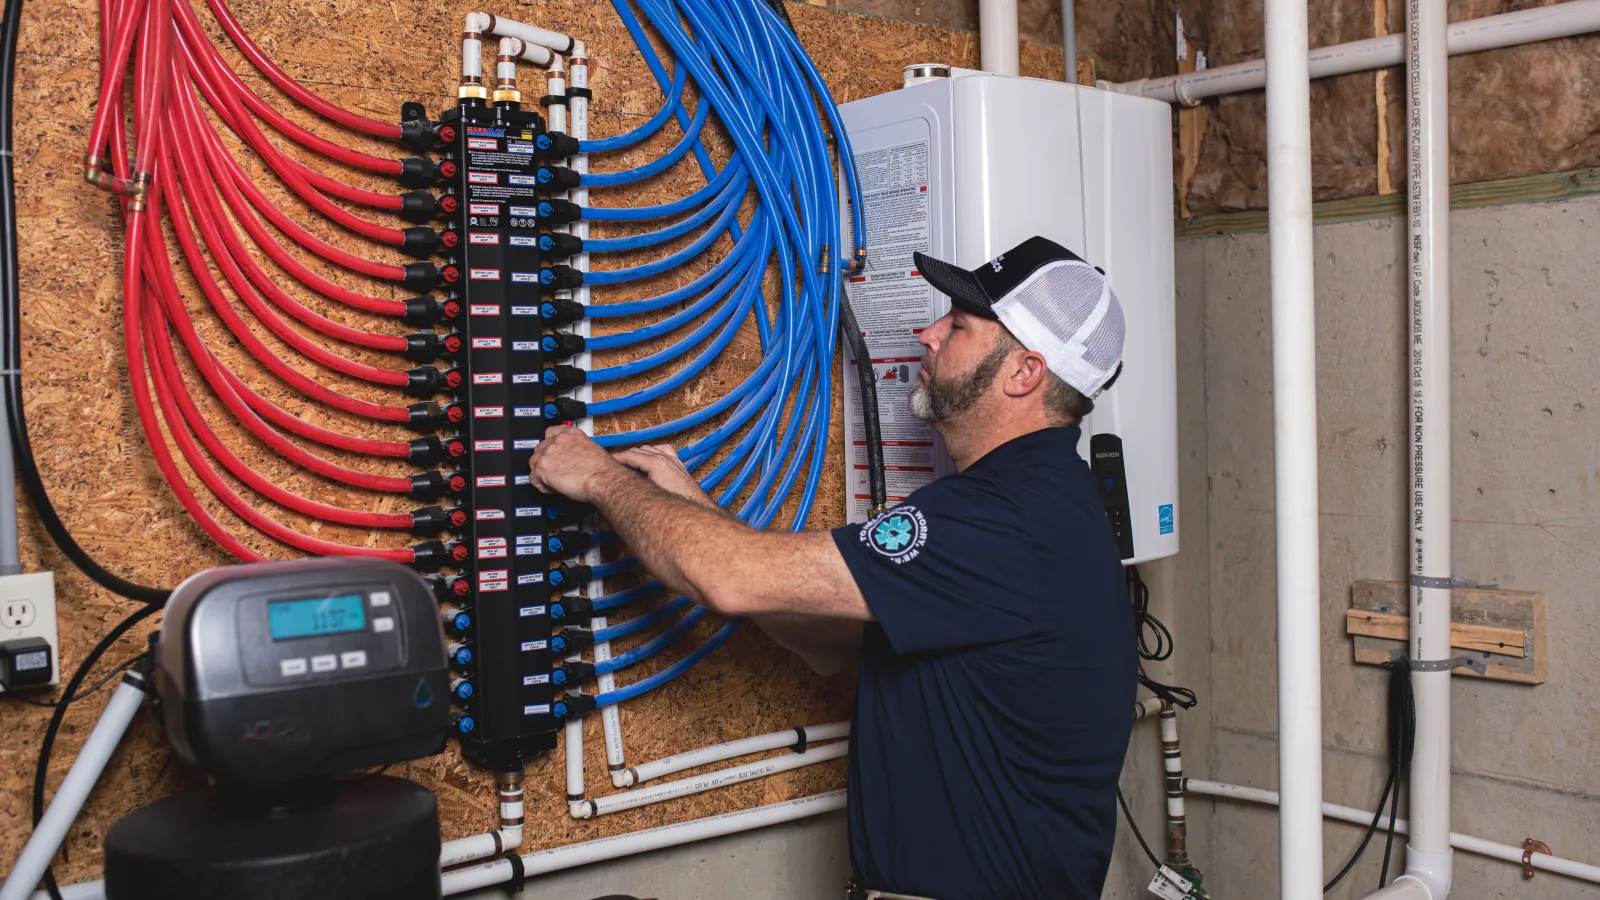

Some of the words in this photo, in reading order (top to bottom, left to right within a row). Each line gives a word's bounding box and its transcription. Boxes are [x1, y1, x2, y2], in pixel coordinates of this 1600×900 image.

[1410, 22, 1420, 70] COEXTRUDED
[1412, 72, 1420, 106] CELLULAR
[1412, 108, 1420, 128] CORE
[1412, 130, 1420, 144] PVC
[1412, 146, 1420, 162] DWV
[1412, 164, 1420, 179] PIPE
[1412, 181, 1421, 200] ASTM
[1414, 234, 1422, 251] NSF
[1414, 280, 1422, 296] Code
[1414, 334, 1422, 345] ME
[1414, 350, 1422, 365] 2016
[1414, 366, 1422, 378] Oct
[1415, 510, 1423, 531] ONLY
[695, 781, 708, 789] PLUS
